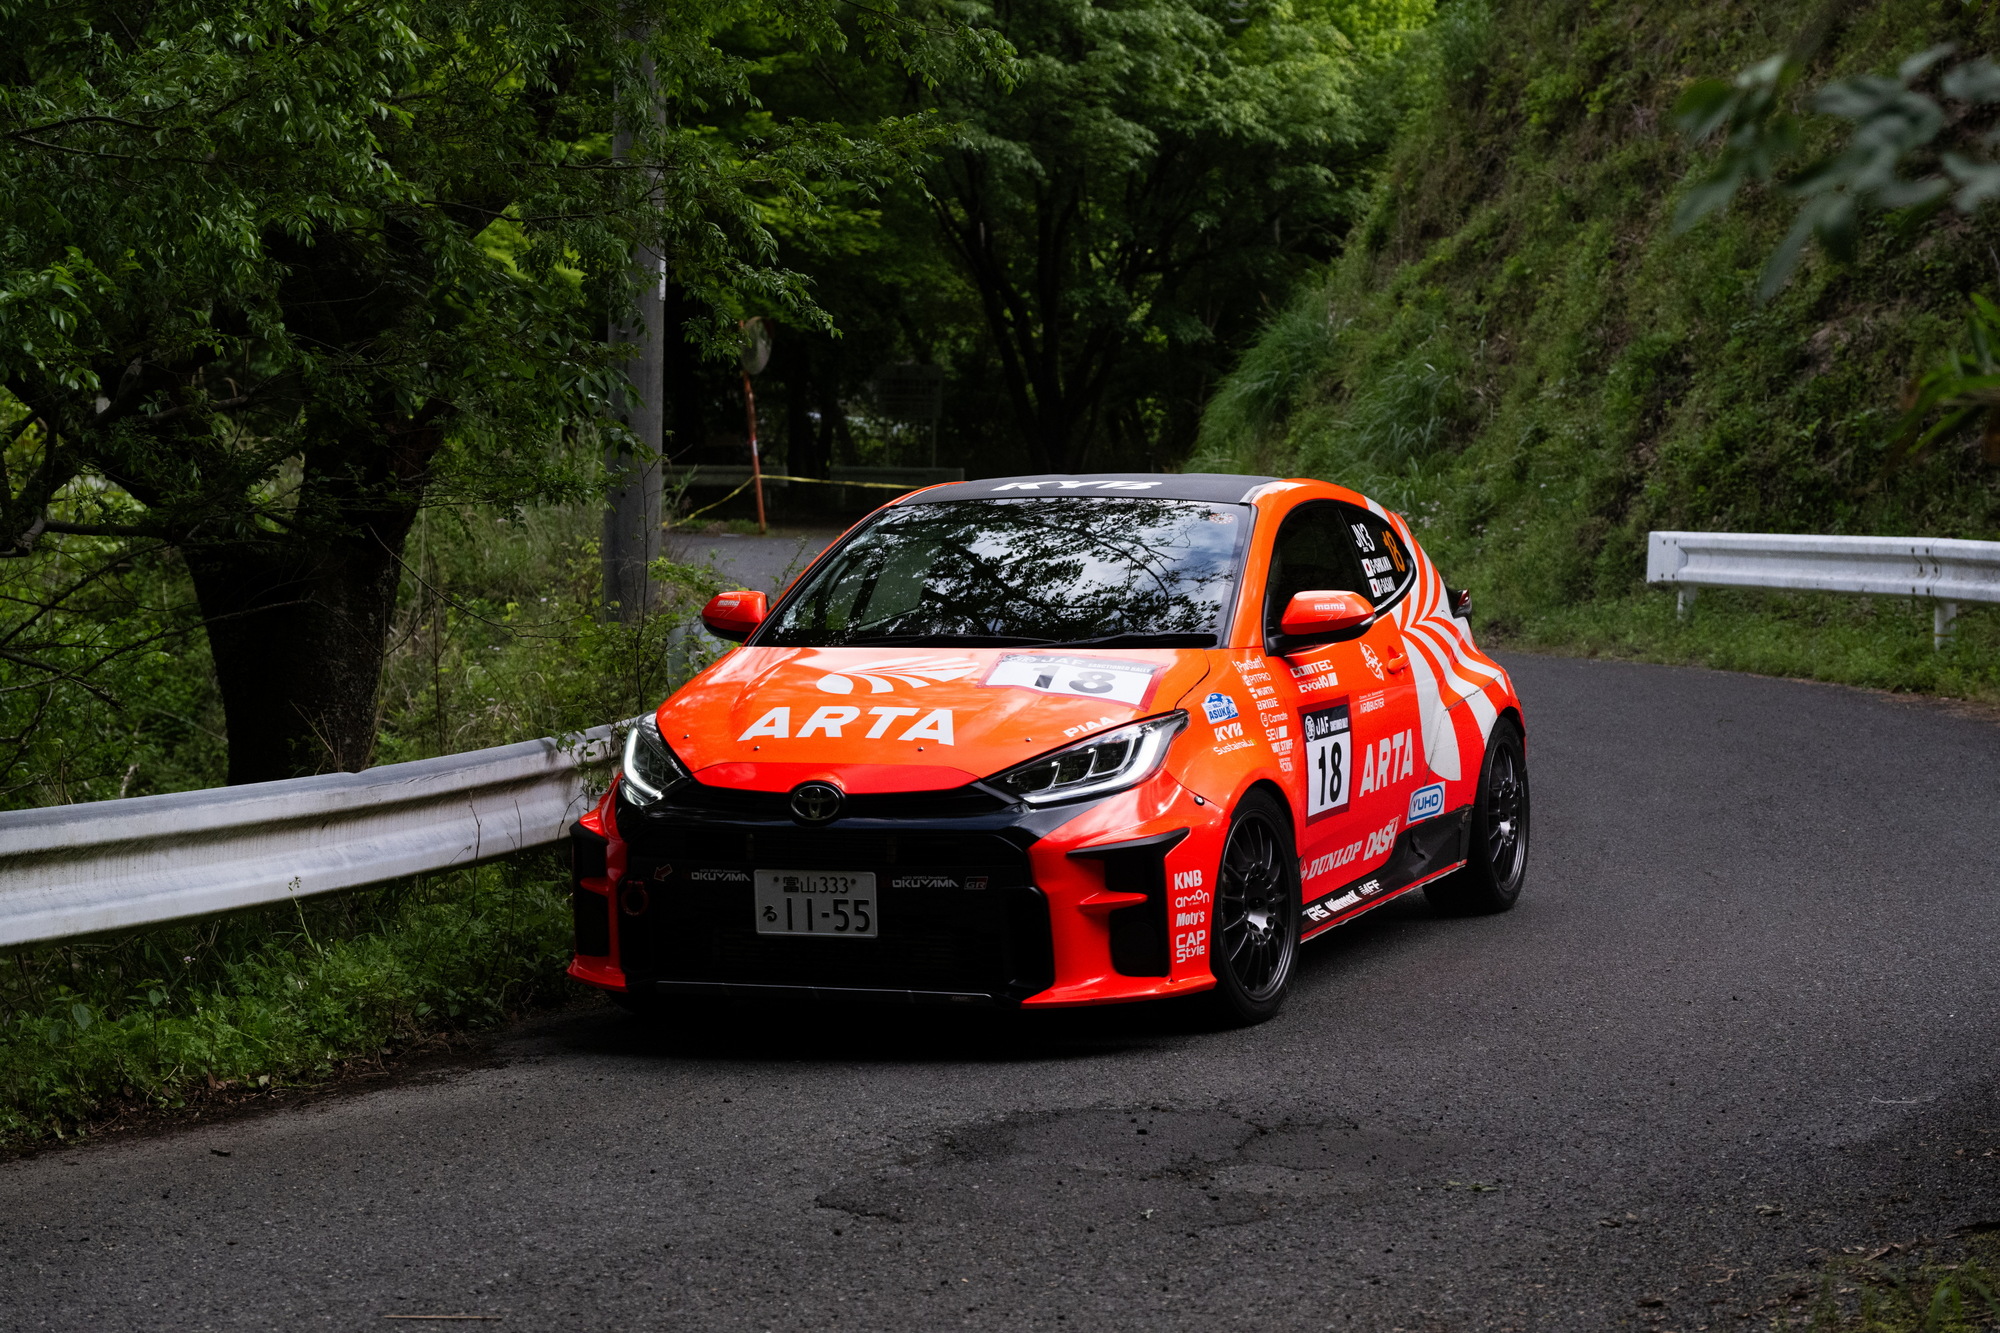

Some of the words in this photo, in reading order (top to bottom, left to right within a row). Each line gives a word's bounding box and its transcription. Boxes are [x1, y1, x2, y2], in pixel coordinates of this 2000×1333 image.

[991, 480, 1162, 492] KYB
[1382, 530, 1405, 572] 18
[1314, 603, 1346, 611] momo
[1040, 656, 1086, 665] JAF
[1291, 659, 1334, 678] COMTEC
[1033, 665, 1116, 694] 18
[1208, 706, 1231, 720] ASUKA
[1256, 698, 1279, 711] BRIDE
[737, 705, 954, 746] ARTA
[1062, 716, 1116, 738] PIAA
[1214, 722, 1244, 742] KYB
[1315, 716, 1329, 735] JAF
[1359, 728, 1413, 798] ARTA
[1318, 741, 1342, 806] 18
[1412, 795, 1438, 812] YUHO
[1307, 840, 1363, 880] DUNLOP
[691, 871, 752, 882] OKUYAMA
[892, 879, 959, 888] OKUYAMA
[1174, 869, 1202, 890] KNB
[1175, 889, 1209, 908] amon
[763, 905, 777, 922] る
[786, 897, 871, 932] 11-55
[1176, 910, 1205, 927] Moty's
[1176, 930, 1206, 949] CAP
[1176, 945, 1205, 963] Style
